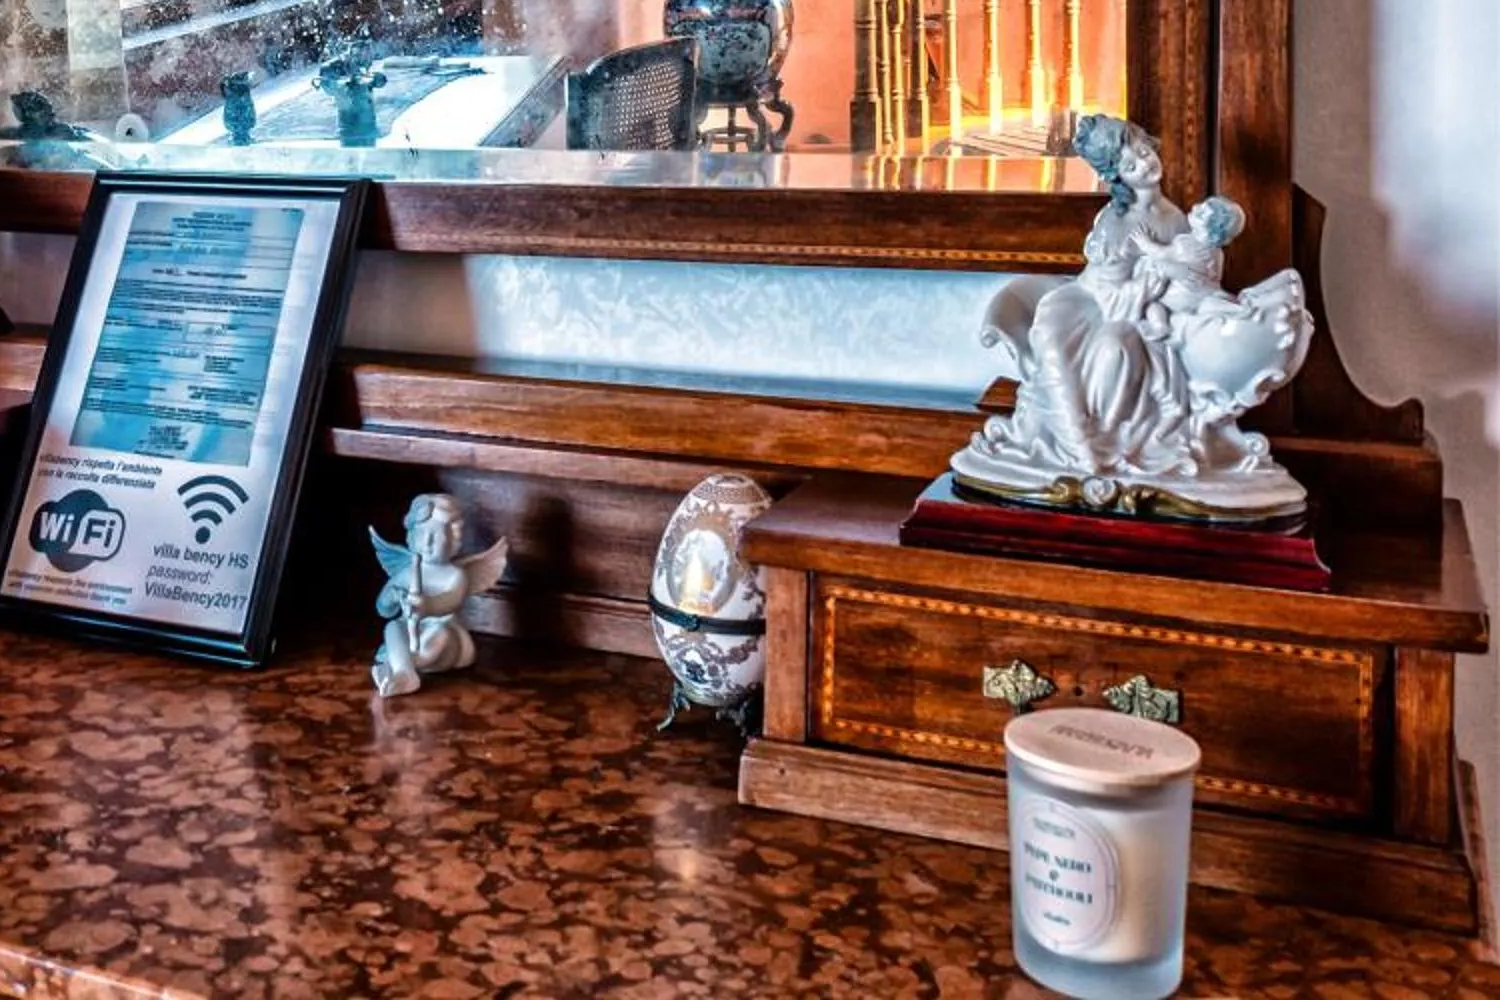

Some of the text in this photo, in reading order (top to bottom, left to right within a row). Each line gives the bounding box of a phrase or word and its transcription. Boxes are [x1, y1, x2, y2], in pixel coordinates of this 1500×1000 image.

[153, 543, 249, 569] villa bency HS
[146, 565, 211, 585] password:
[145, 581, 248, 609] VillaBency2017
